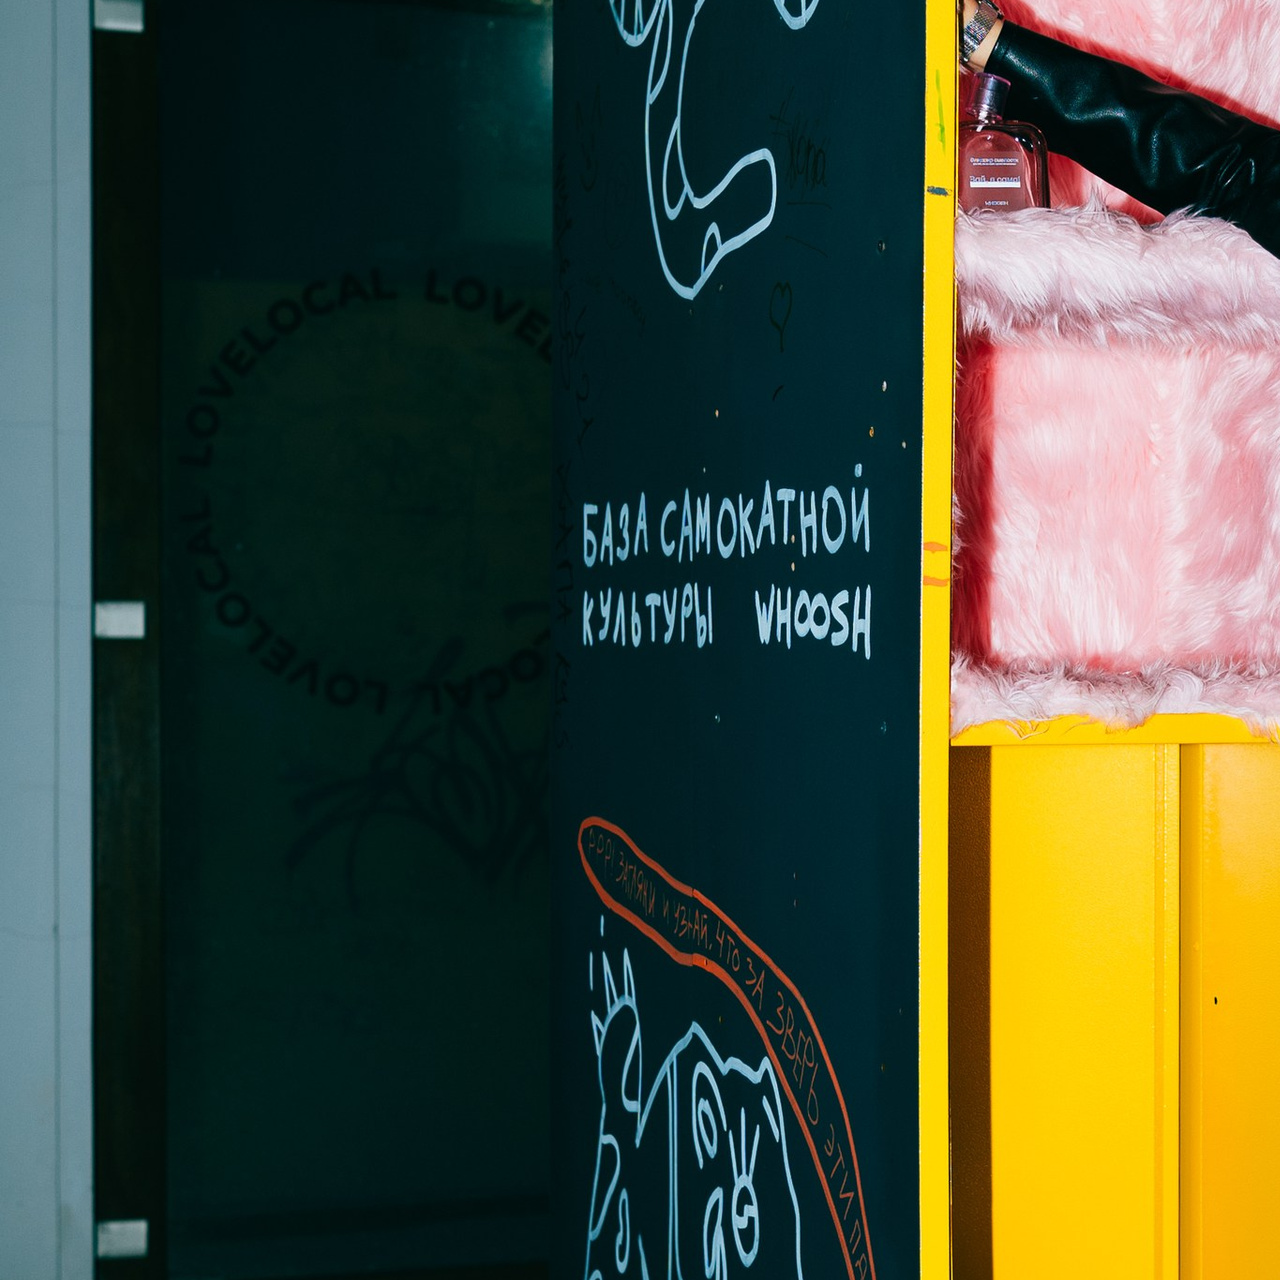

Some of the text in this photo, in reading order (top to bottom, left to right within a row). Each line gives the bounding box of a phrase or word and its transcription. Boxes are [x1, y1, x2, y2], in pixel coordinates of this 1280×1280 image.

[179, 266, 400, 469] LOVELOCAL
[179, 500, 390, 716] LOVELOCAL
[583, 491, 649, 568] БАЗА
[660, 463, 871, 559] САМОКАТНОЙ
[582, 582, 872, 661] КУЛЬТУРЫ WHOOSH
[716, 920, 741, 973] ЧТО
[745, 956, 766, 1012] ЗА
[766, 990, 820, 1126] ЗВЕРЬ
